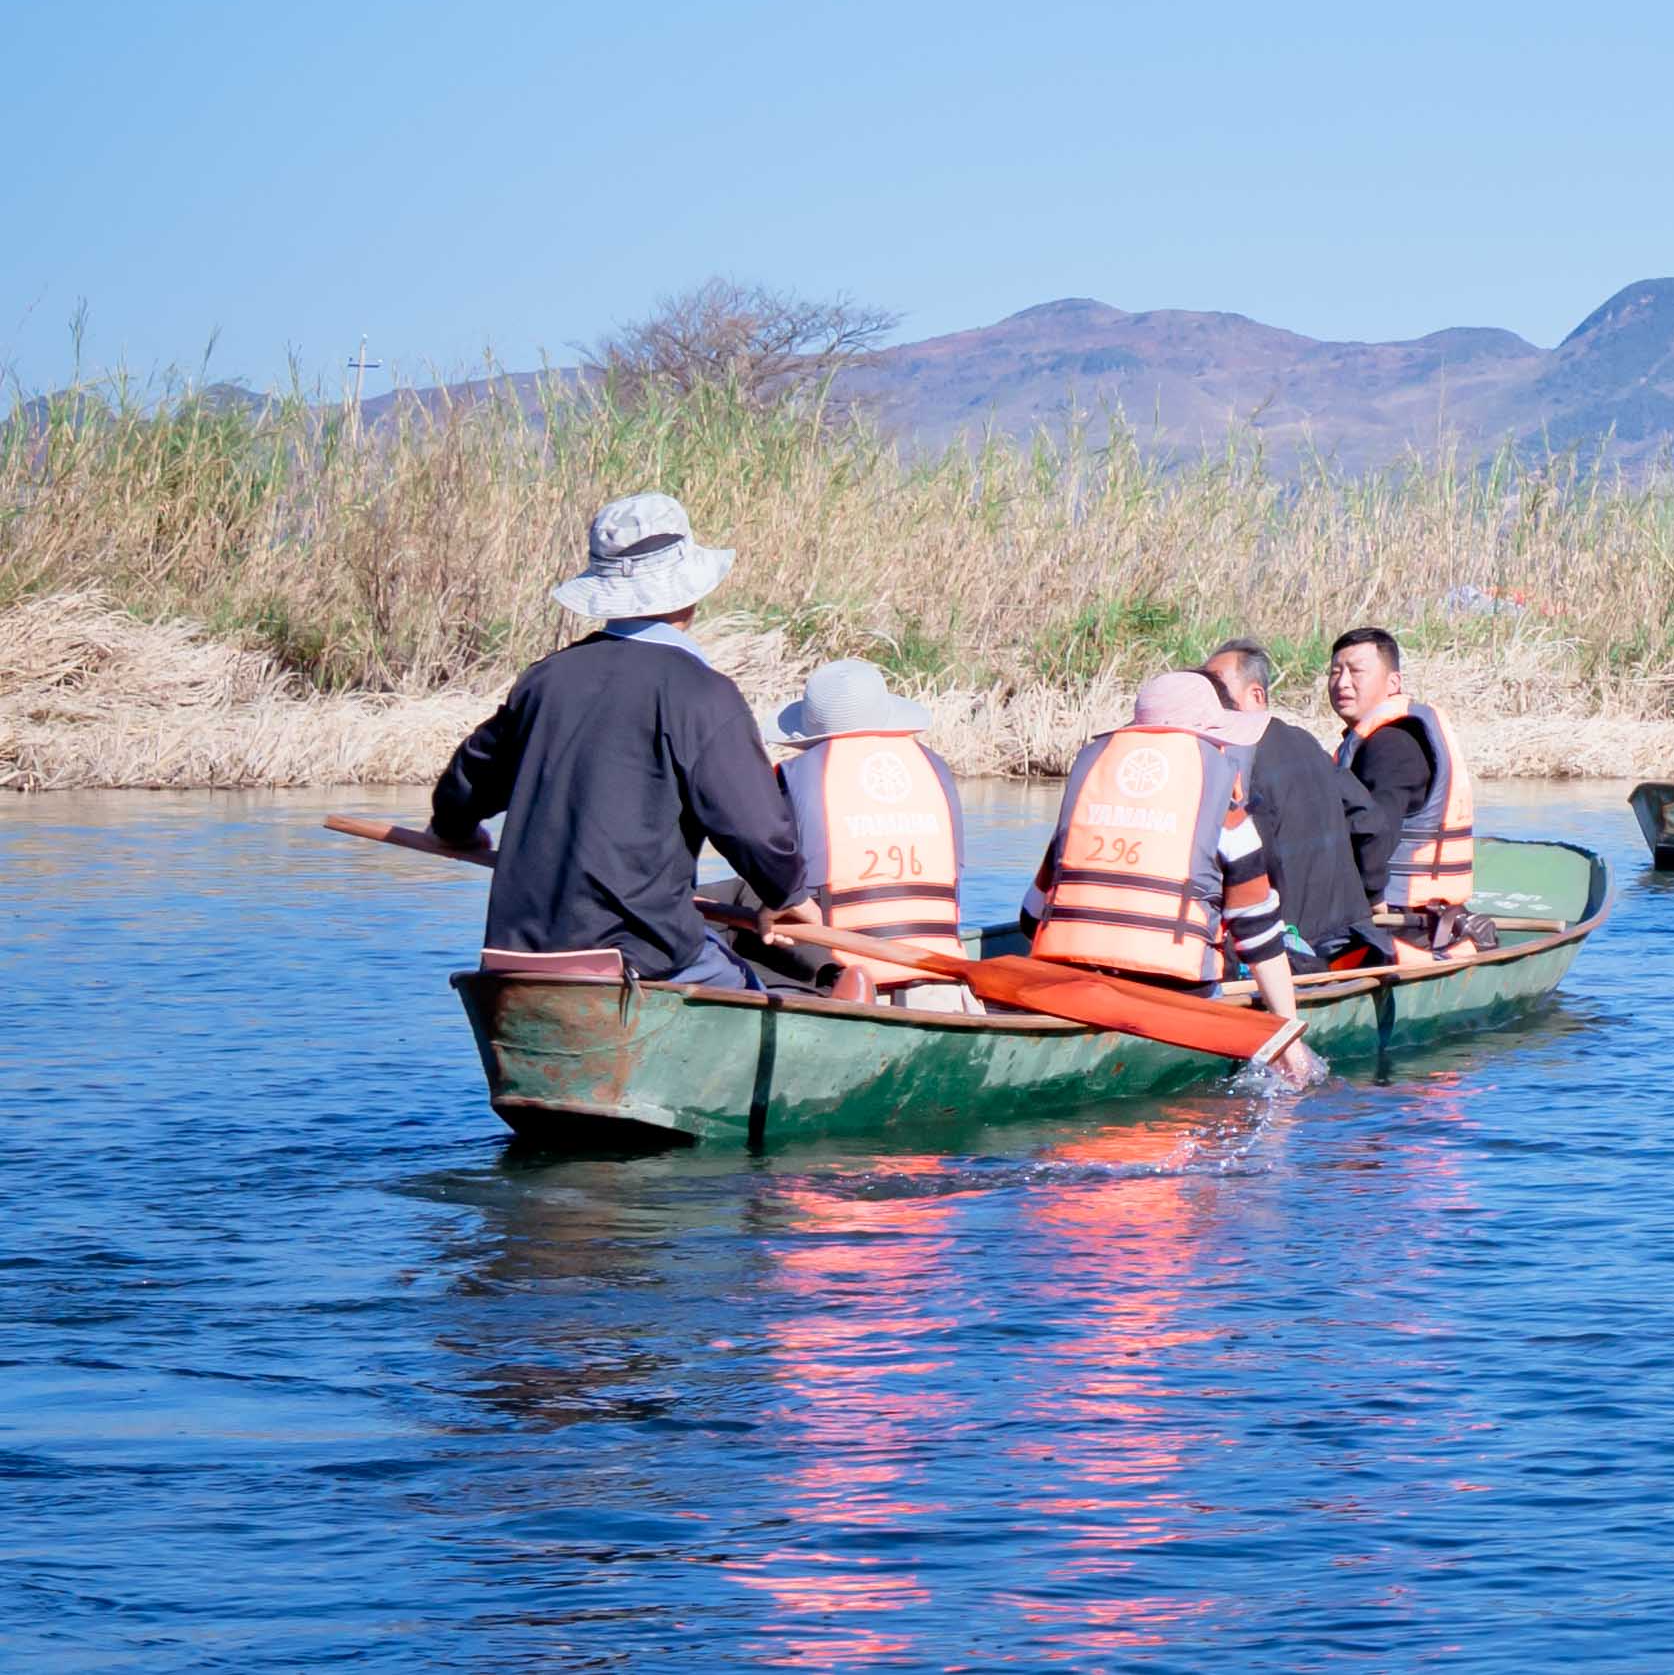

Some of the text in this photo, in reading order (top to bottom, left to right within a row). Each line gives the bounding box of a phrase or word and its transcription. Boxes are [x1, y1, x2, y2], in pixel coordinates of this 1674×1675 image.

[1086, 803, 1177, 834] YAMAHA
[858, 844, 922, 880] 296
[1085, 834, 1143, 865] 296
